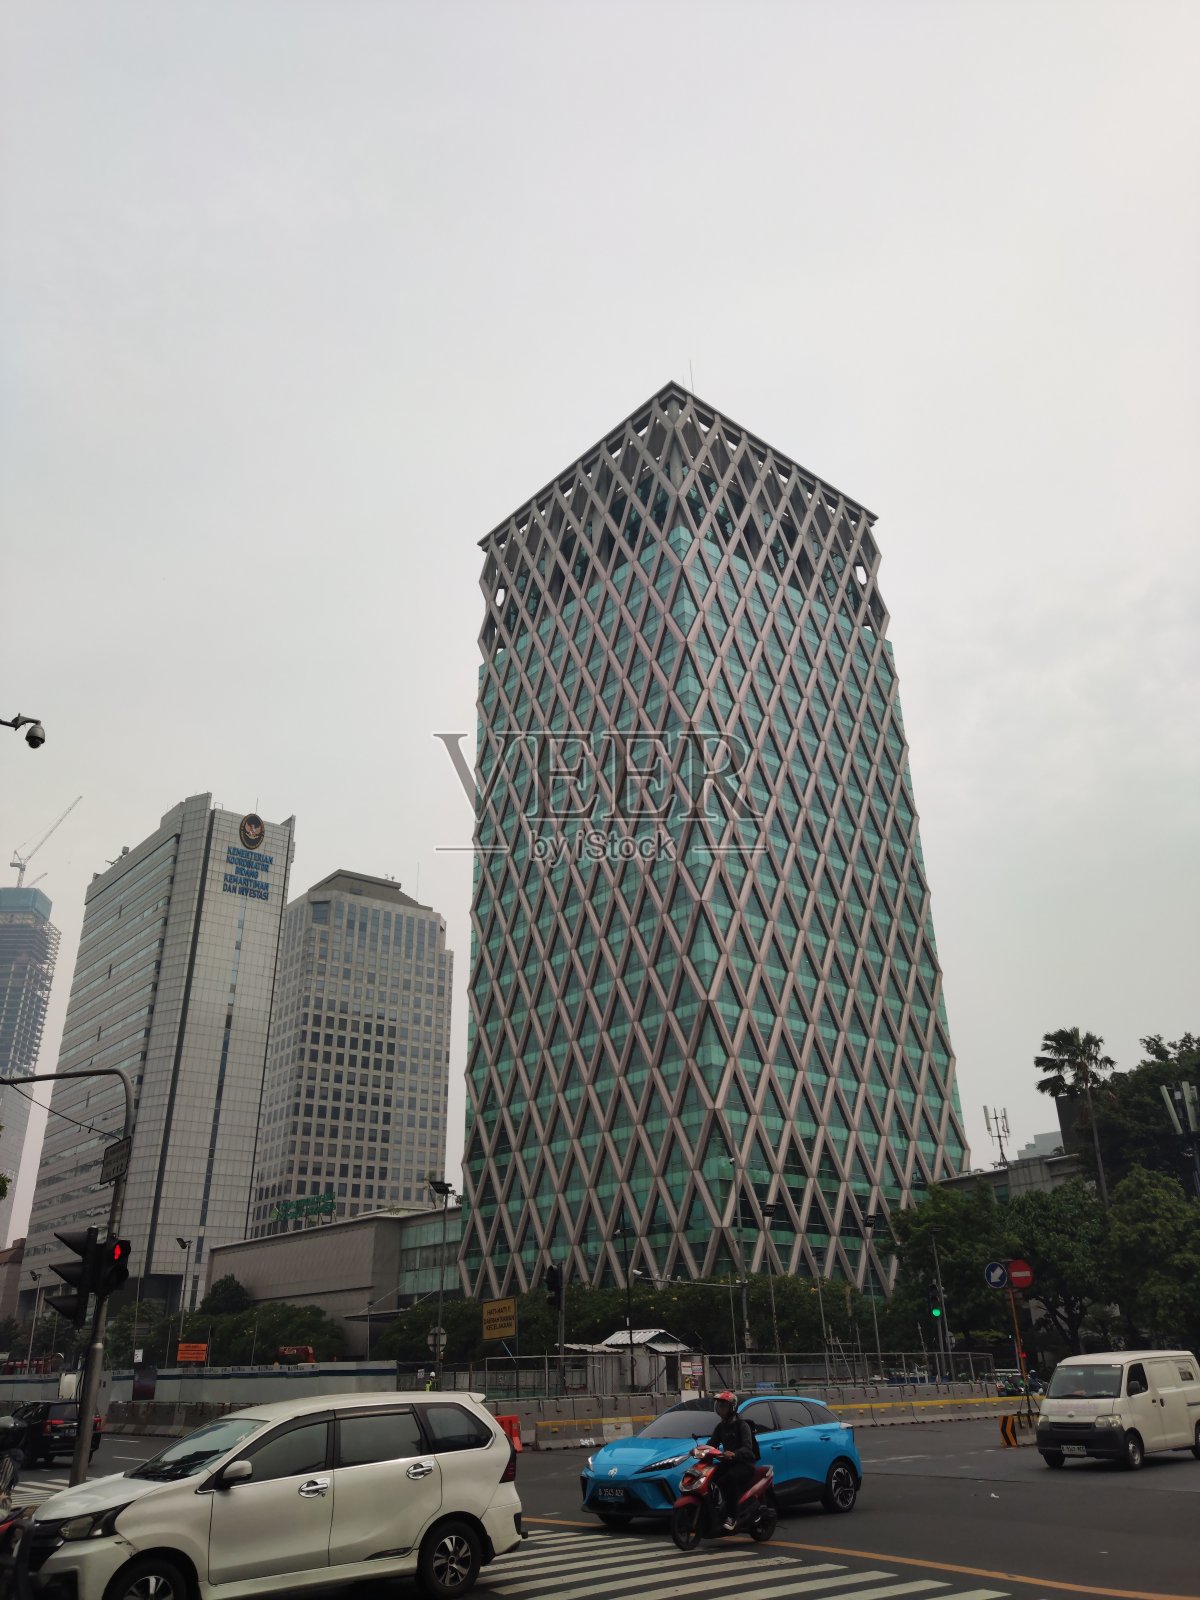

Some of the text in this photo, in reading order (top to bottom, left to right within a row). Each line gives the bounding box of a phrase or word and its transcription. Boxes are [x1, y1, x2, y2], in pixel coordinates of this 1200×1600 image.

[226, 855, 270, 872] KOORDINATOR
[227, 846, 273, 864] KEMENTERIAN
[235, 866, 259, 879] BIDANG
[224, 873, 270, 890] KEMARITIMAN
[223, 883, 269, 900] DAN INVESTASI
